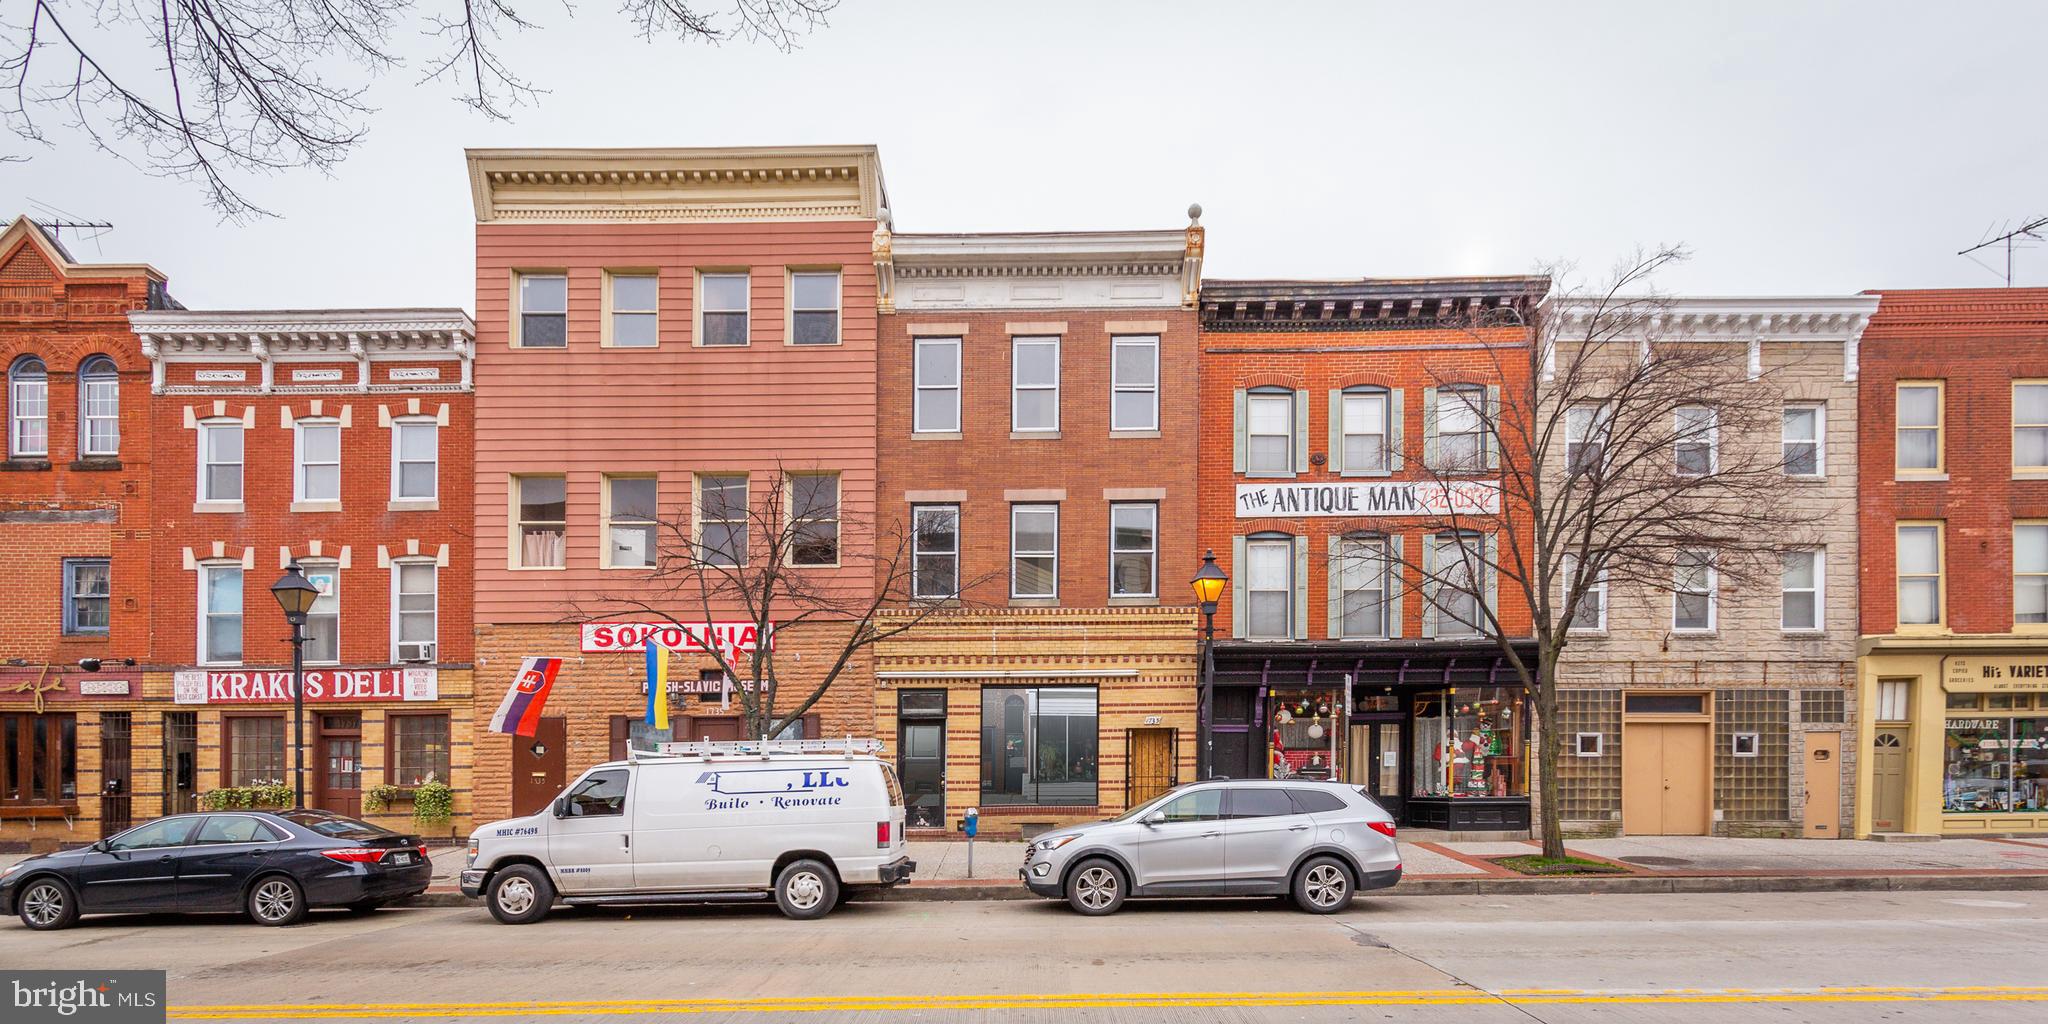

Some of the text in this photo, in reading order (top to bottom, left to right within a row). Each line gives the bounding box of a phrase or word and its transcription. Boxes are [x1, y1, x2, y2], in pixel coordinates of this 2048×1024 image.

[1240, 489, 1268, 510] THE
[1272, 487, 1359, 513] ANTIQUE
[1367, 486, 1415, 510] MAN
[594, 626, 760, 647] SOKOLNIA
[210, 670, 403, 700] KRAKUS DELI
[1945, 719, 1999, 729] HARDWARE
[771, 796, 841, 809] Renovate
